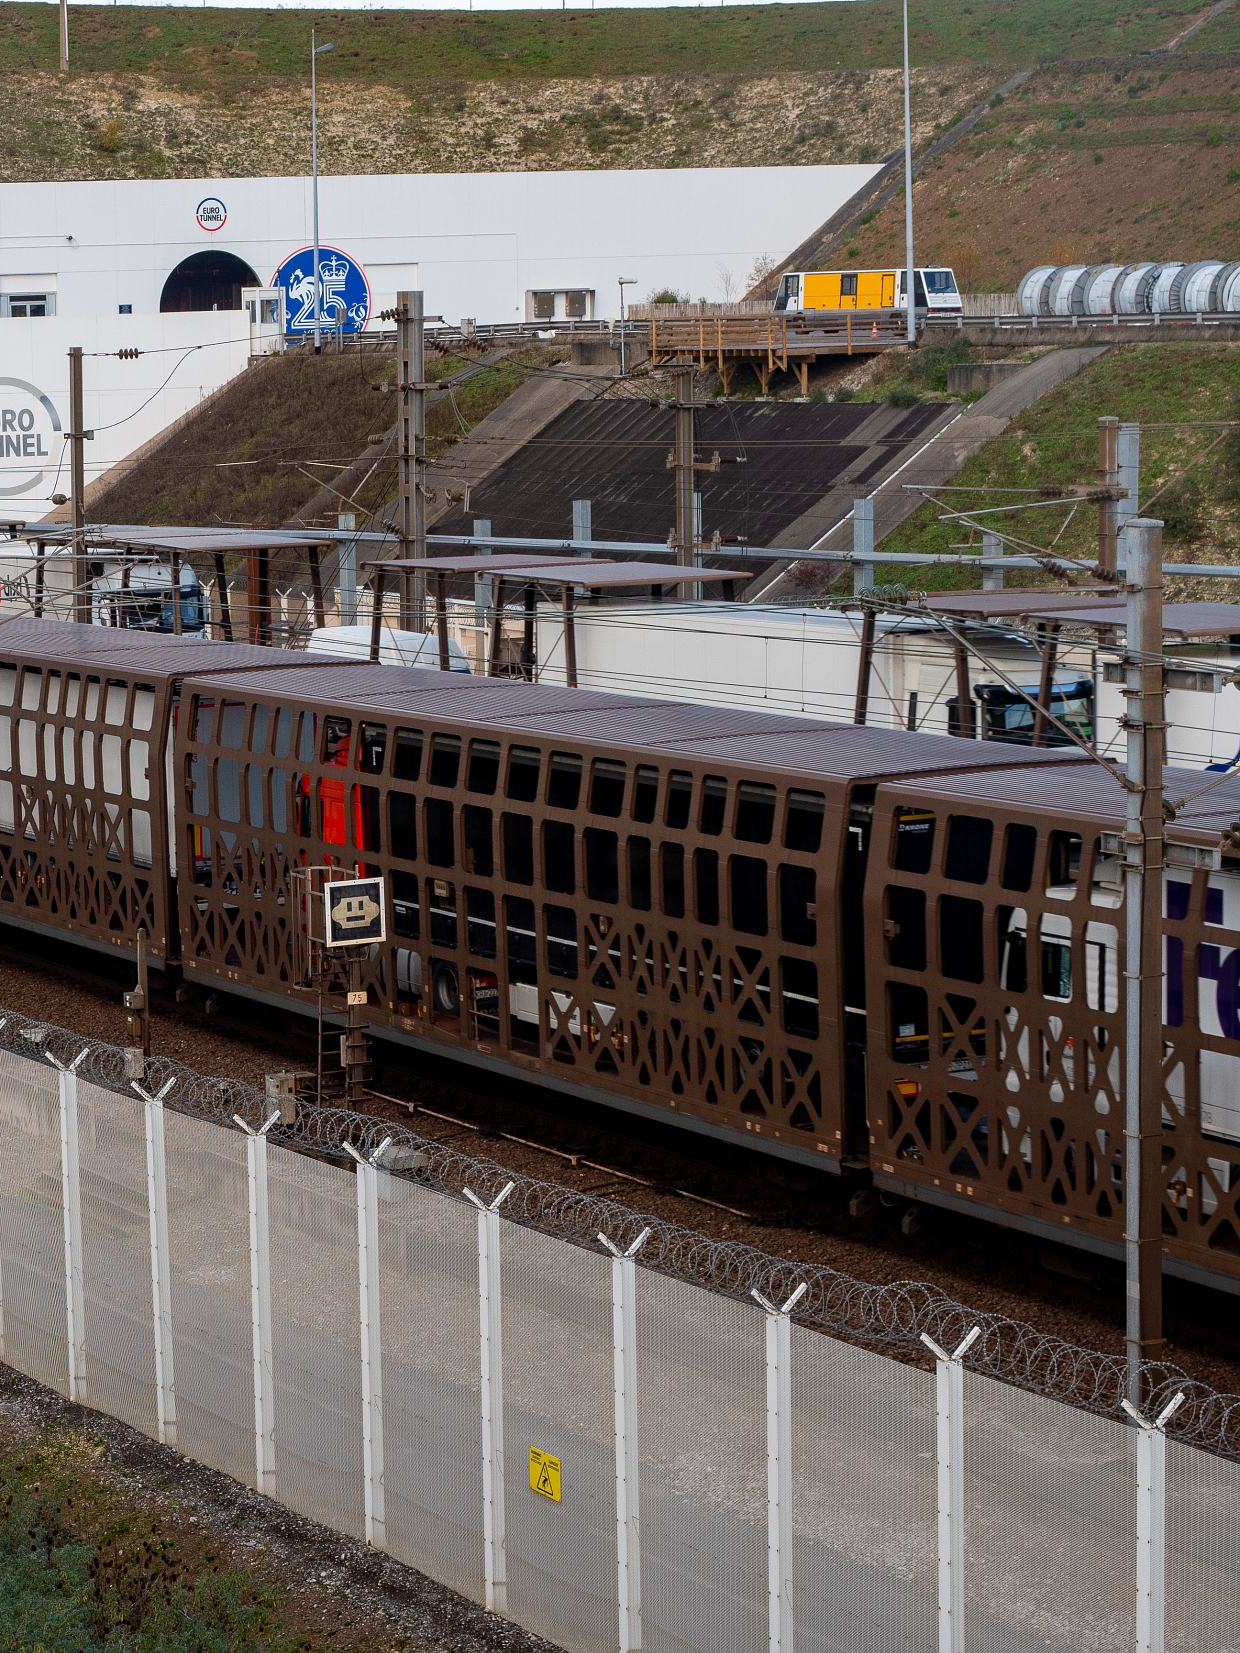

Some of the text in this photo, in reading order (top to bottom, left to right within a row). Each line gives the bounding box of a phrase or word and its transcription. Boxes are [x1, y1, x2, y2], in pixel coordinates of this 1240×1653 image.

[202, 206, 220, 214] EURO
[199, 214, 223, 222] TUNNEL
[290, 276, 348, 329] 25
[352, 993, 362, 1003] 75
